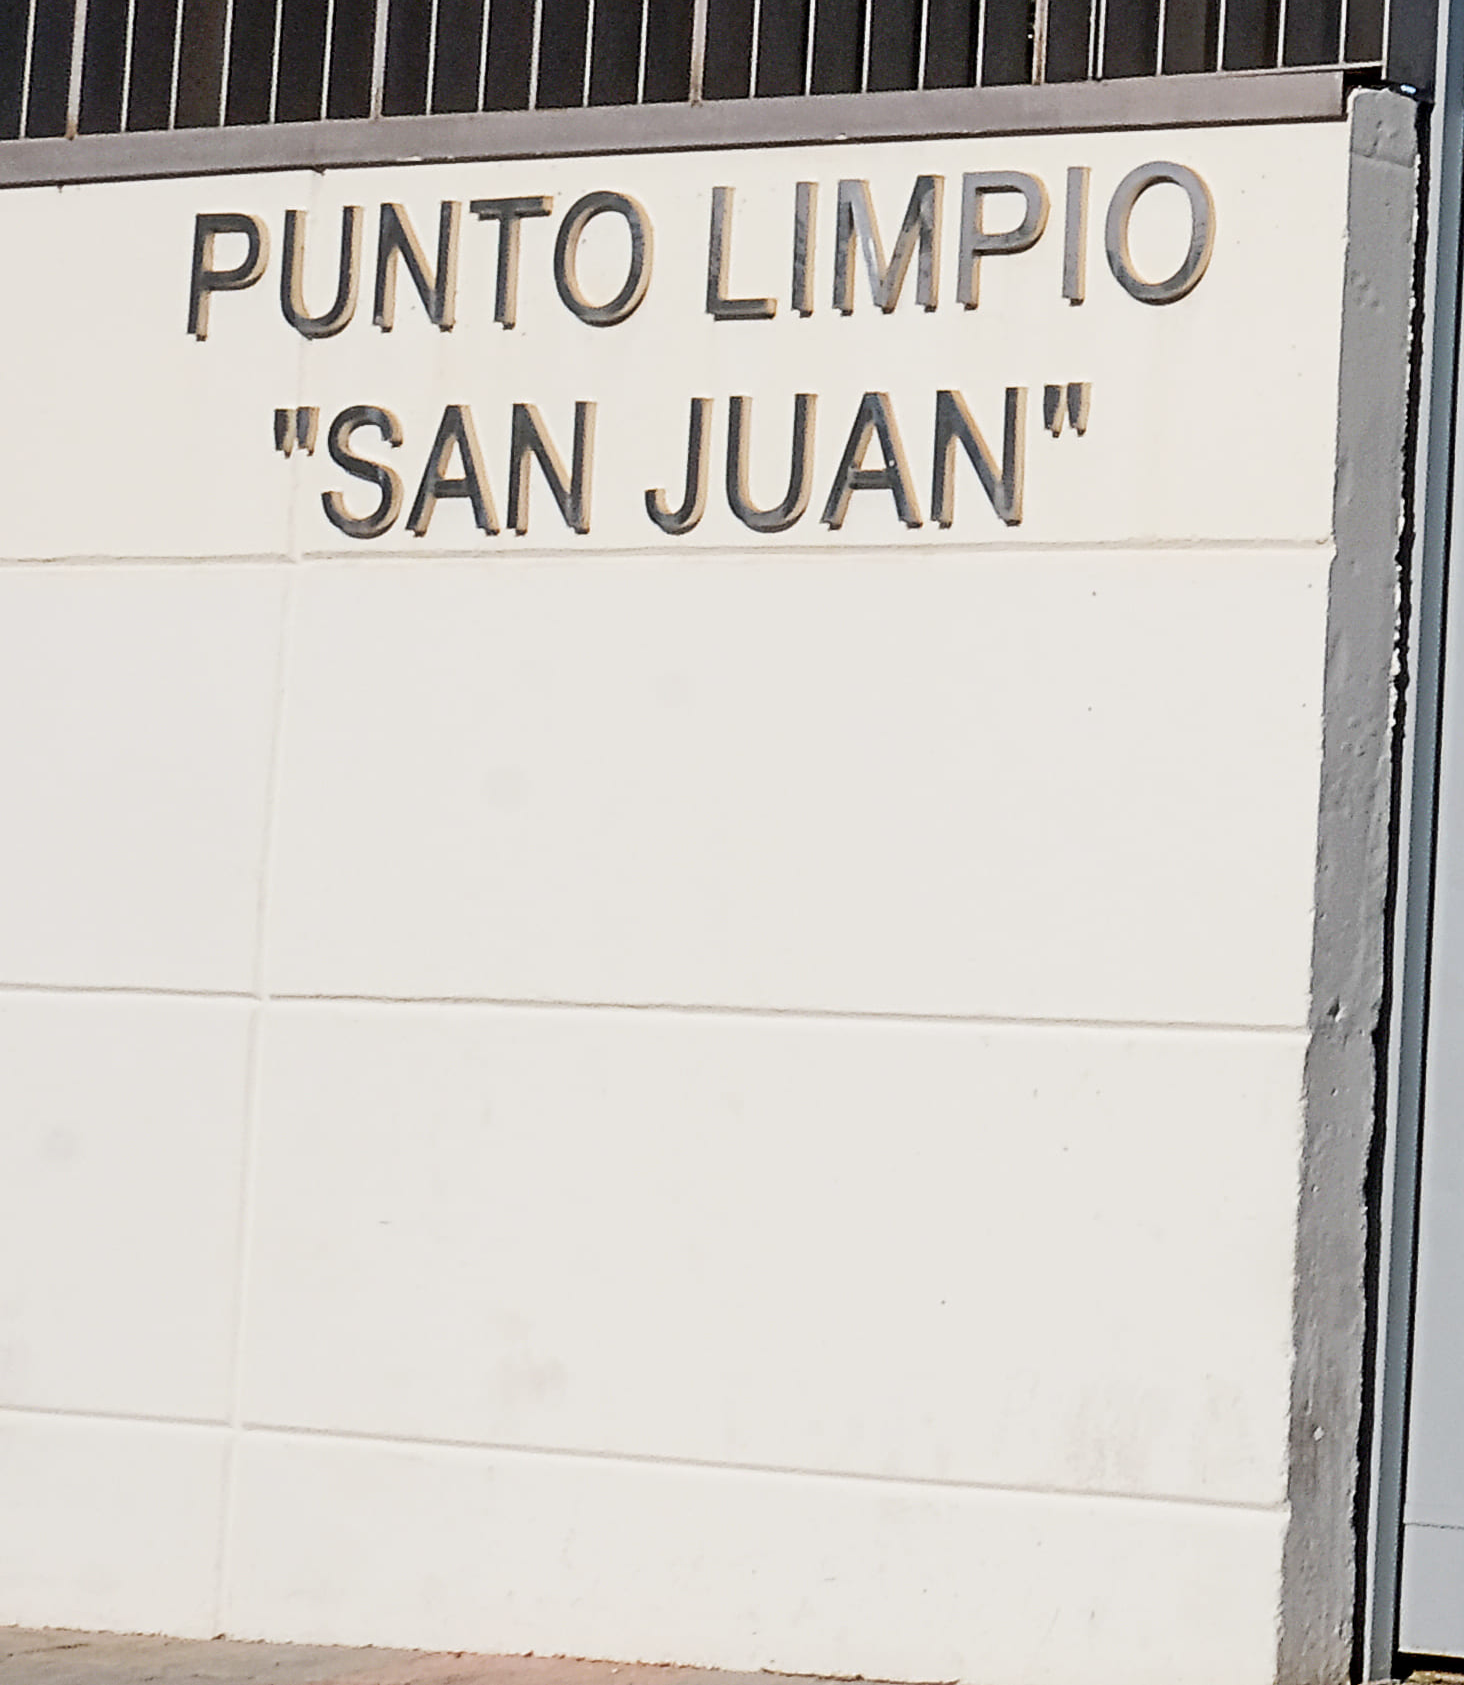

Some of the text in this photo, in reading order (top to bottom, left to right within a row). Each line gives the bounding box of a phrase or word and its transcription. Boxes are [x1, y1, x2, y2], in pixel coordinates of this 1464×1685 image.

[186, 160, 1218, 341] PUNTO LIMPIO
[273, 382, 1092, 538] "SAN JUAN"
